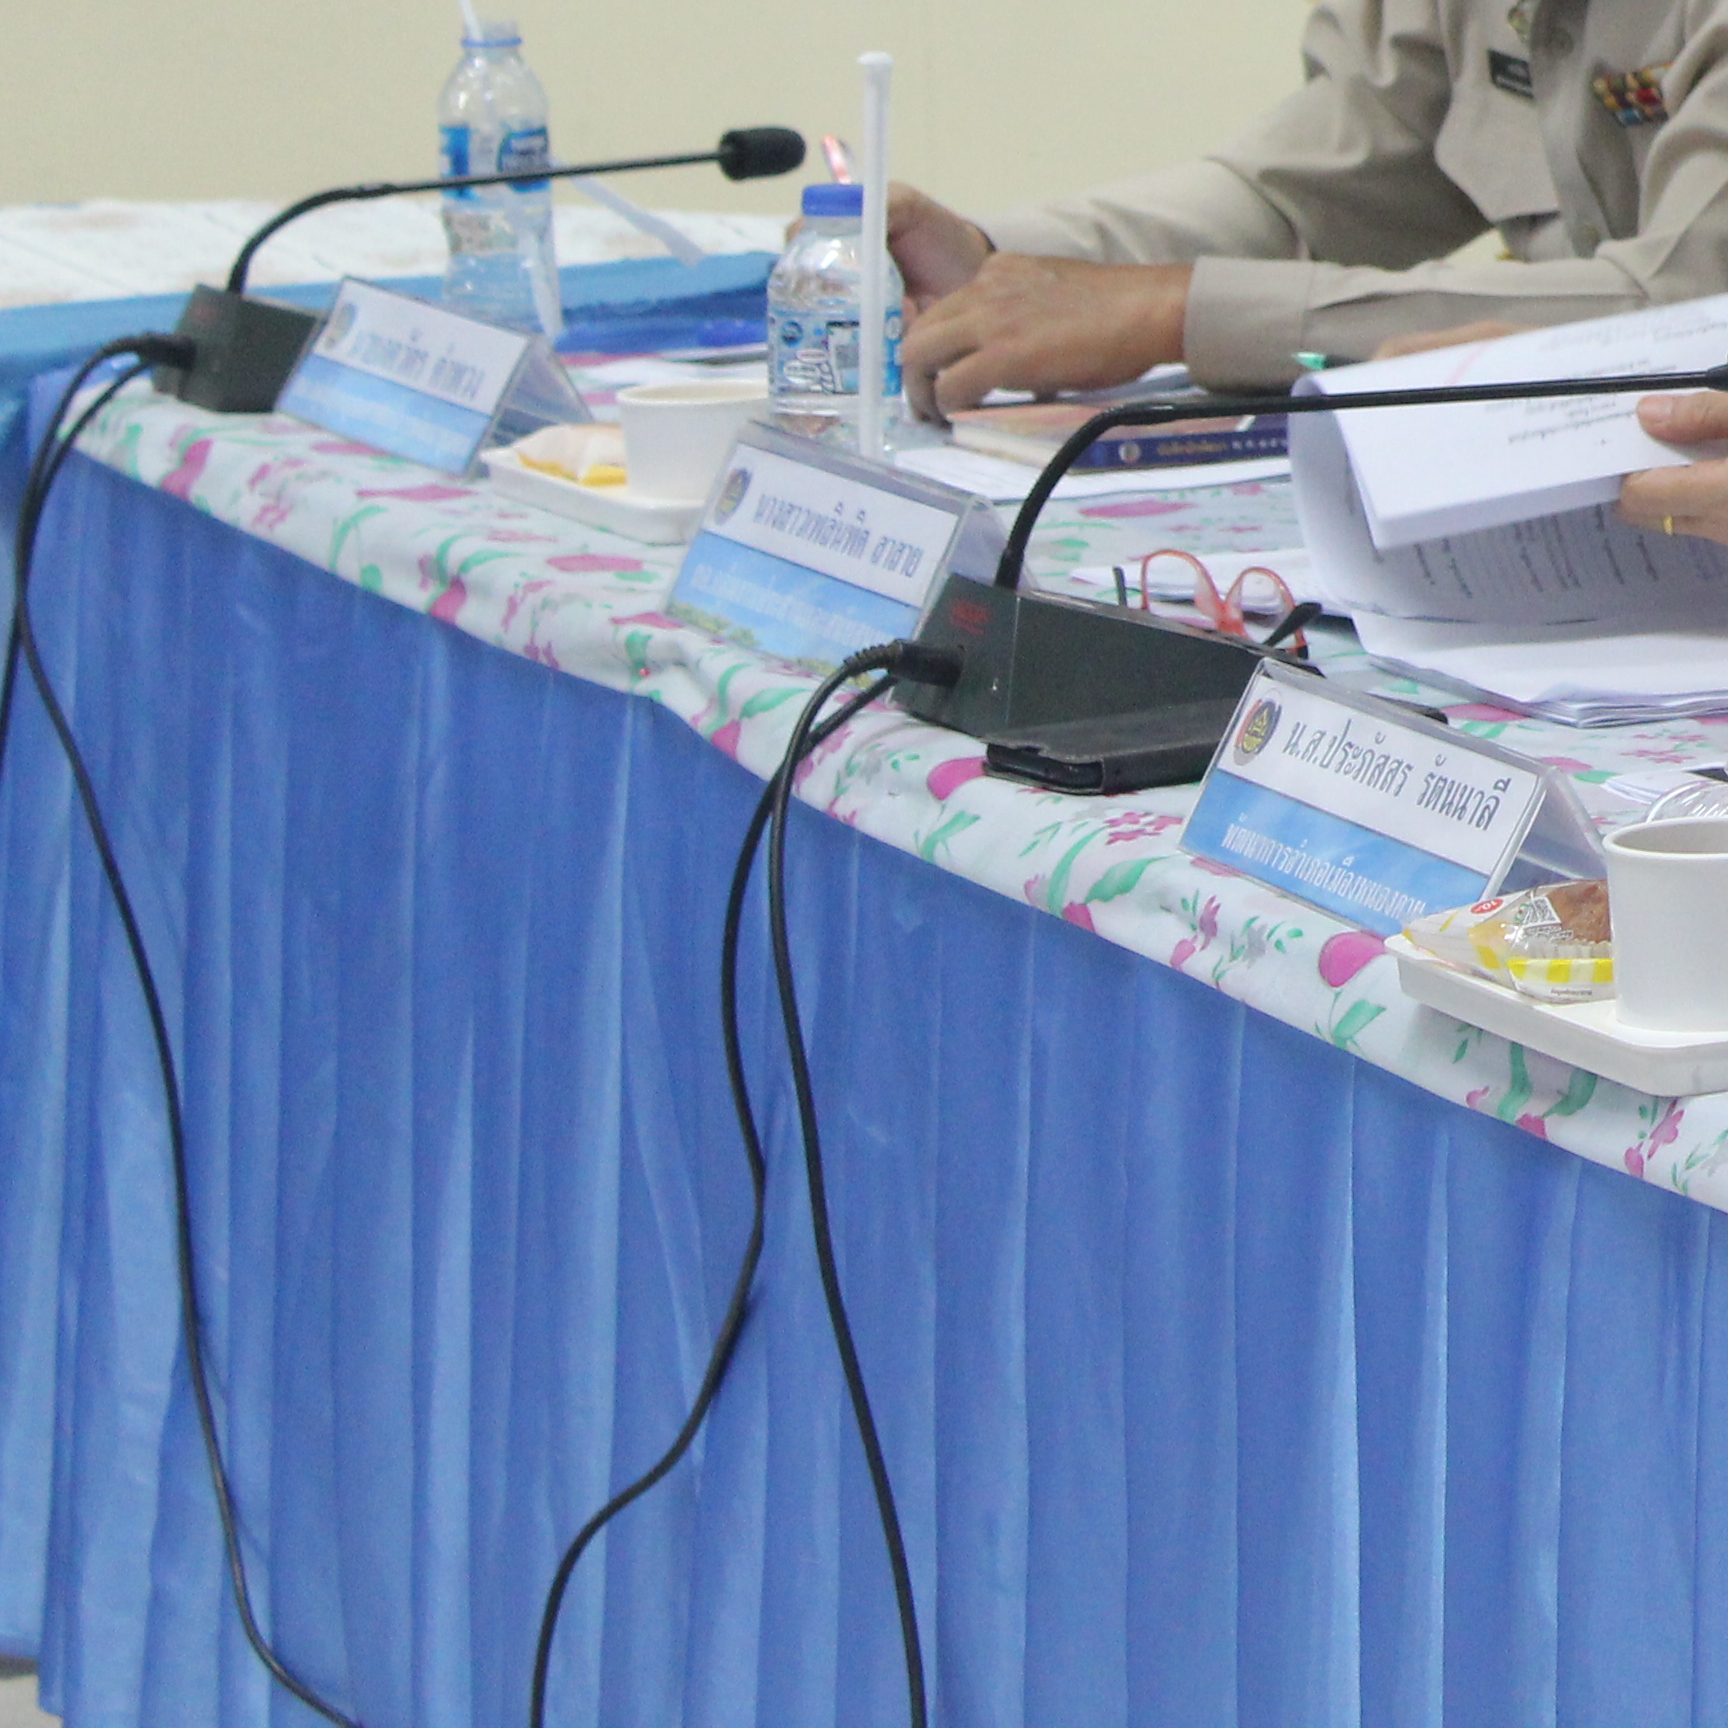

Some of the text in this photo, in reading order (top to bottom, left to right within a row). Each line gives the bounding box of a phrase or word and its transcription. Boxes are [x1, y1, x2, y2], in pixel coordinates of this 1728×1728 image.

[1282, 719, 1512, 832] น.ส.ประภัสสร รัตนนาลี
